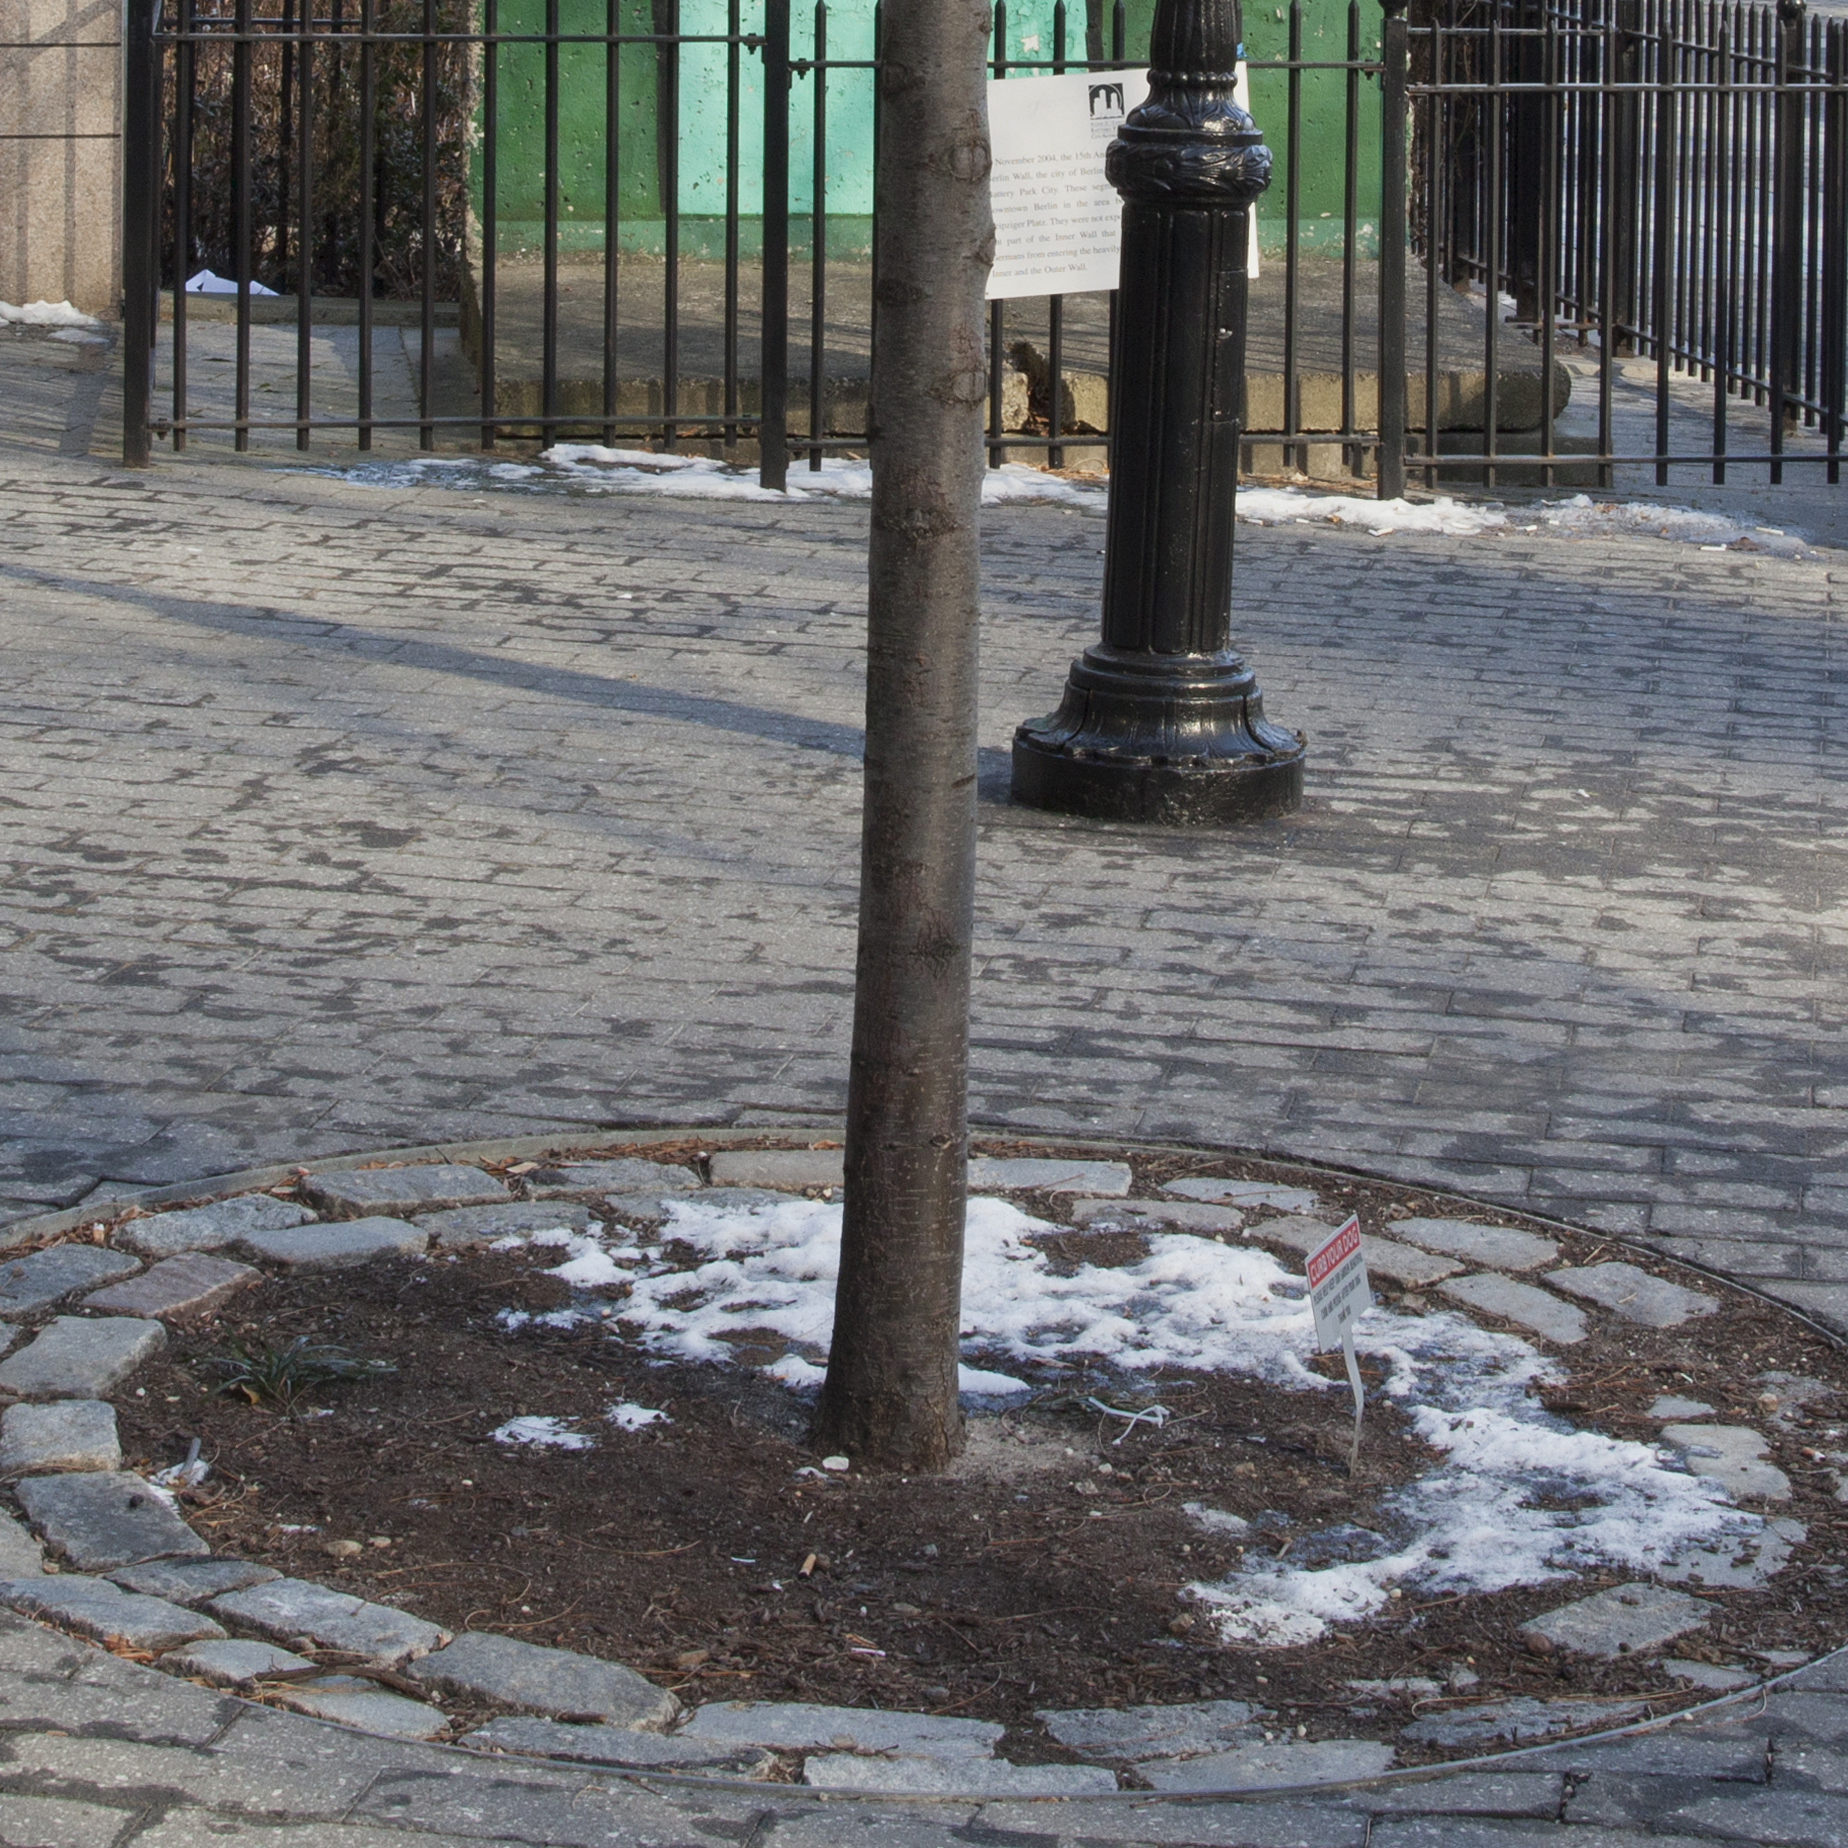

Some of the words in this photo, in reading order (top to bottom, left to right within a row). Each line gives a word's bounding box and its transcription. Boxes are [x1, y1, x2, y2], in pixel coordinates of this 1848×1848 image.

[995, 156, 1035, 166] November
[1037, 154, 1058, 163] 2004,
[1060, 153, 1072, 161] the
[1075, 152, 1092, 160] 15th
[1093, 151, 1107, 159] An
[990, 174, 1010, 183] erlin
[1012, 172, 1033, 181] Wall,
[1036, 171, 1048, 179] the
[1050, 170, 1065, 179] city
[1068, 168, 1077, 176] of
[1080, 167, 1104, 176] Berlin
[990, 190, 1014, 199] attery
[1019, 187, 1037, 196] Park
[1065, 184, 1087, 193] These
[1092, 183, 1113, 192] segm
[991, 206, 1028, 214] owntown
[1034, 202, 1058, 211] Berlin
[1063, 200, 1071, 209] in
[1076, 199, 1089, 208] the
[1094, 199, 1111, 207] area
[995, 221, 1025, 231] eipziger
[1050, 217, 1068, 226] They
[1007, 237, 1022, 247] part
[1025, 235, 1035, 243] of
[1039, 234, 1051, 242] the
[1055, 233, 1075, 241] Inner
[1079, 230, 1097, 239] Wall
[1101, 230, 1116, 238] that
[995, 254, 1026, 262] ermans
[1046, 249, 1078, 258] entering
[1079, 247, 1091, 255] the
[1092, 245, 1121, 255] heavily
[992, 270, 1012, 278] Inner
[1014, 268, 1028, 276] and
[1030, 266, 1042, 274] the
[1044, 265, 1066, 274] Outer
[1068, 263, 1088, 272] Wall.
[1310, 1254, 1328, 1283] CURB
[1326, 1240, 1345, 1268] YOUR
[1342, 1225, 1358, 1252] DOG
